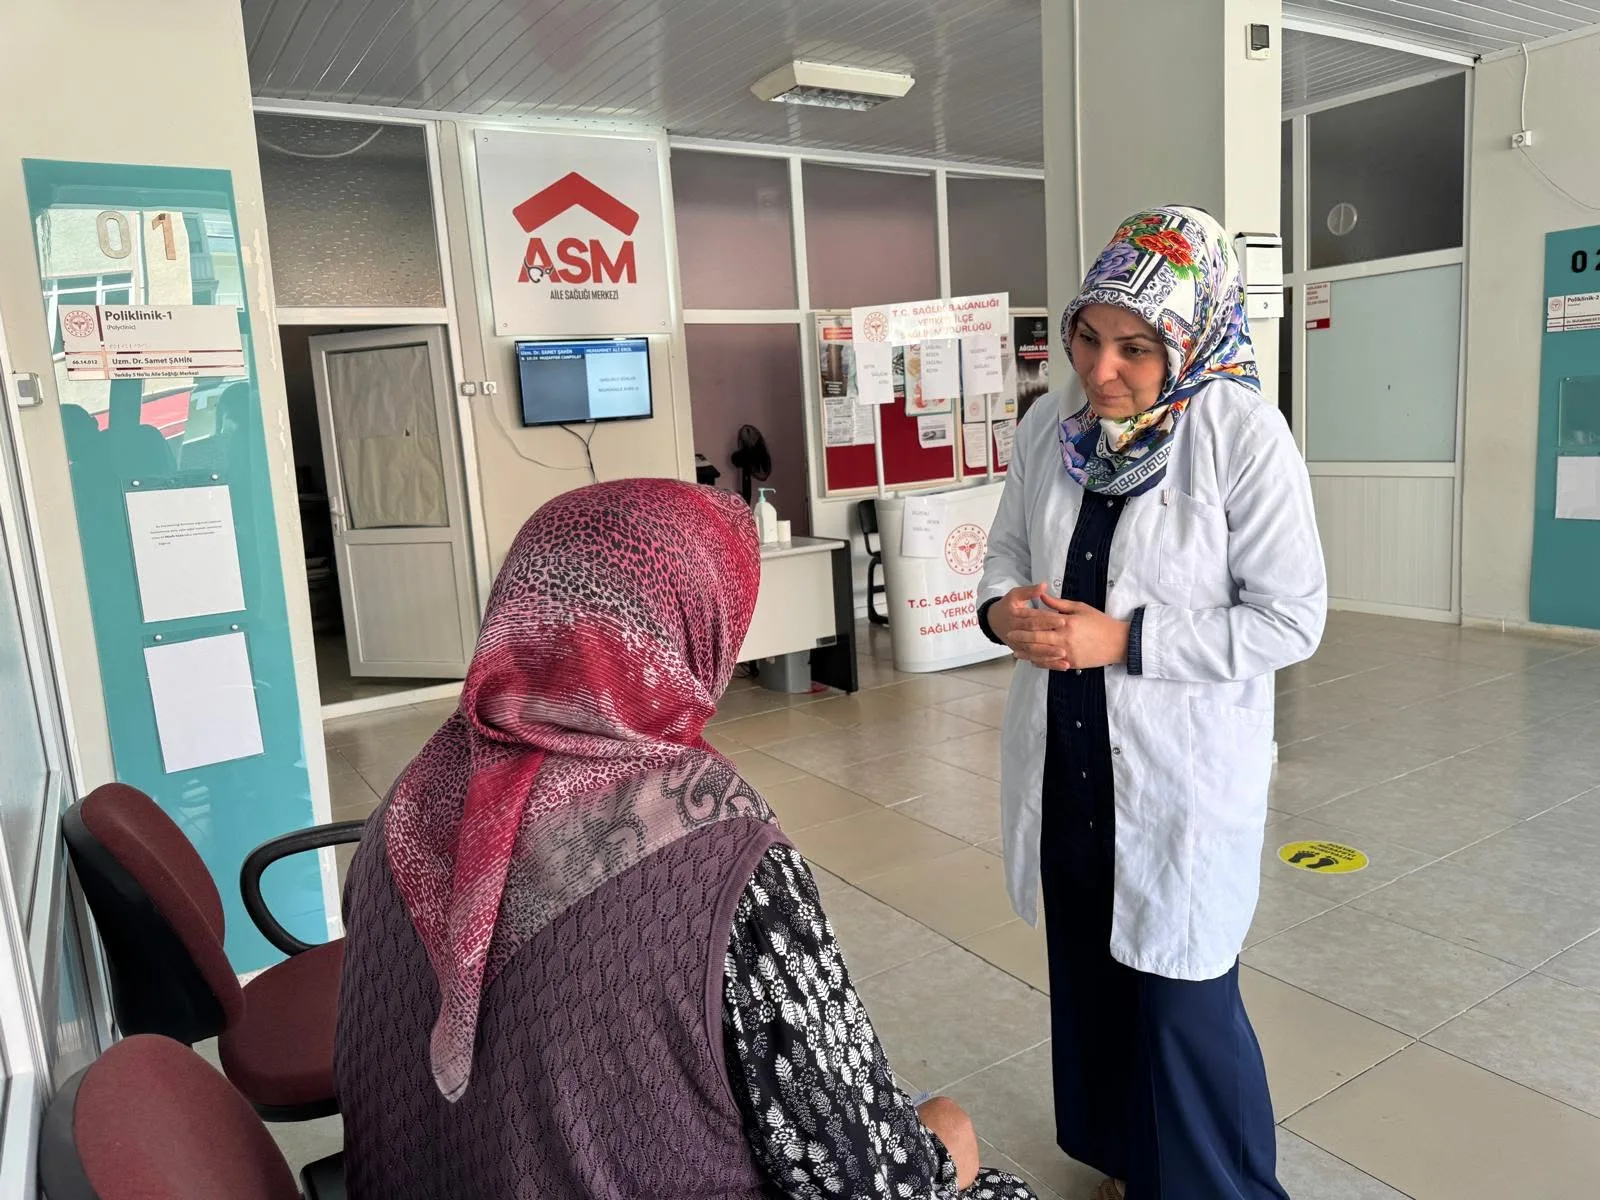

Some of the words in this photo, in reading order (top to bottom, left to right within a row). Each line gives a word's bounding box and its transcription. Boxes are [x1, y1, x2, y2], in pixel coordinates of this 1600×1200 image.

[518, 237, 637, 284] ASM
[550, 288, 565, 300] AİLE
[565, 288, 591, 300] SAĞLIĞI
[592, 289, 619, 300] MERKEZİ
[1567, 295, 1600, 303] Poliklinik-2
[948, 298, 999, 311] BAKANLIĞI
[105, 310, 172, 321] Poliklinik-1
[169, 356, 193, 365] ŞAHİN
[907, 598, 931, 609] T.C.
[934, 590, 974, 605] SAĞLIK
[941, 602, 976, 618] YERKÖ
[919, 620, 959, 636] SAĞLIK
